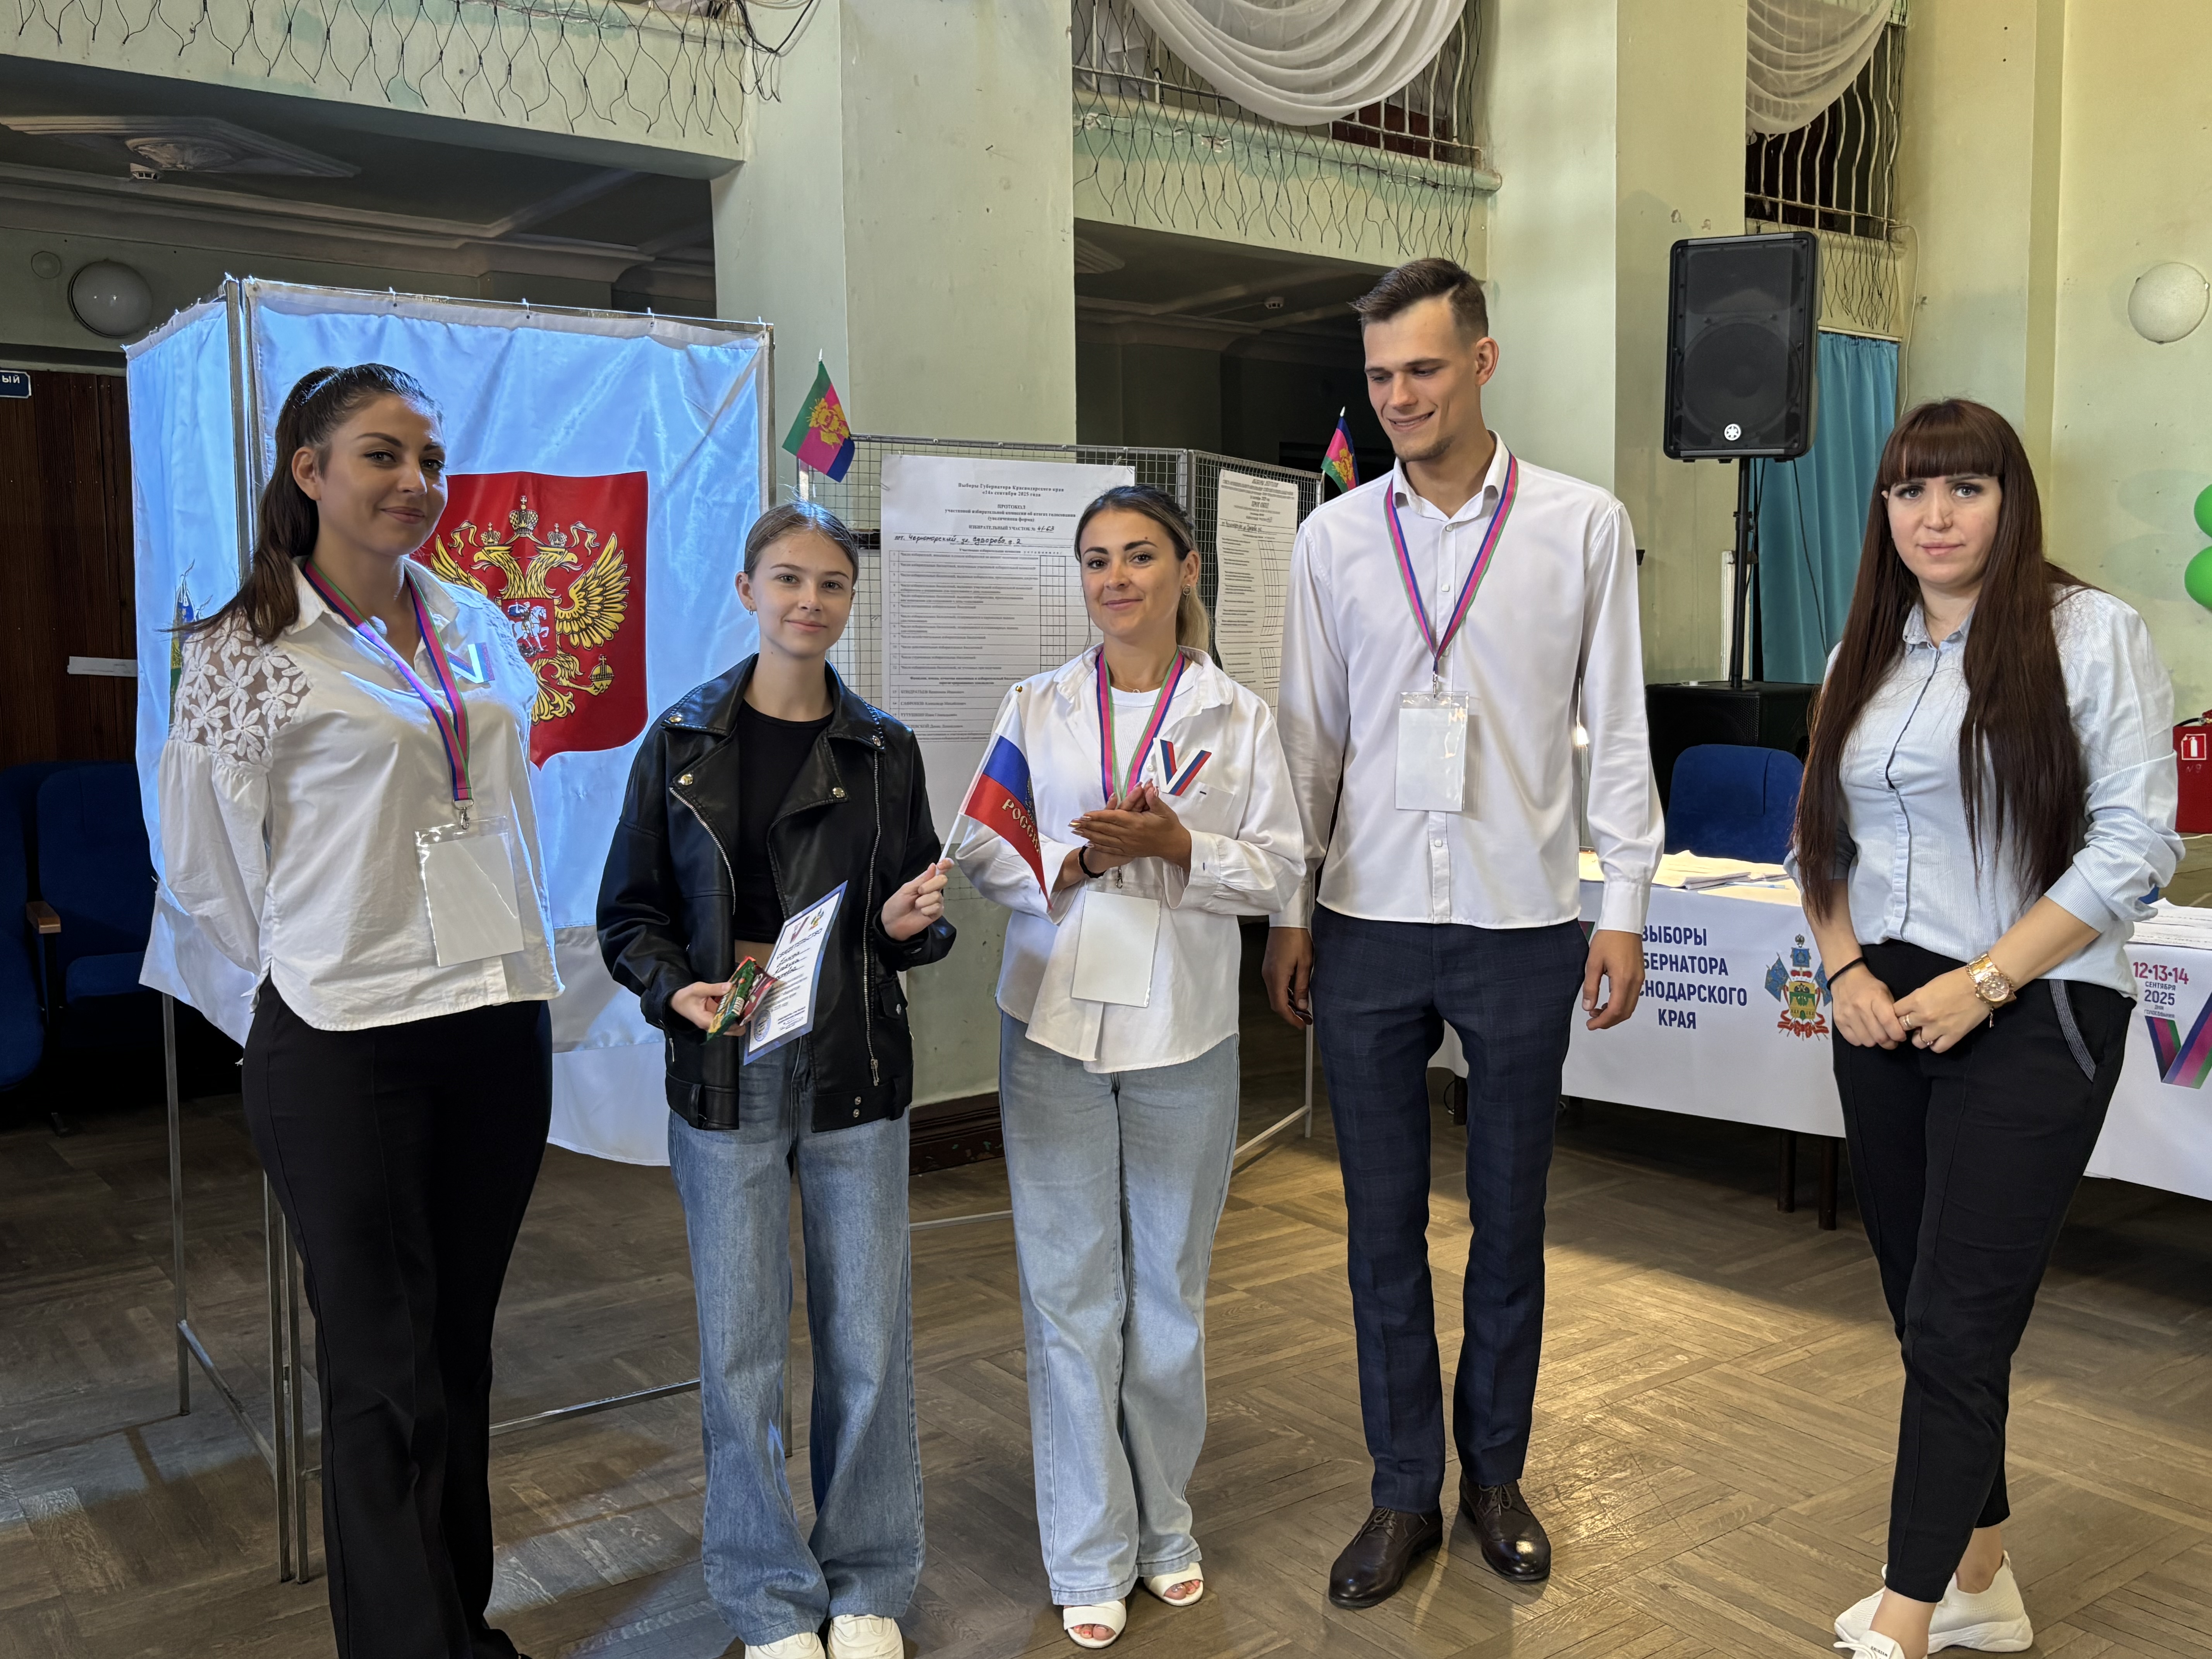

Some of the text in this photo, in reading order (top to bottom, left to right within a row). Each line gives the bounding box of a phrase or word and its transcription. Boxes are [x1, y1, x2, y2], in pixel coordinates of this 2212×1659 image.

[1644, 952, 1728, 976] БЕРНАТОРА
[1639, 980, 1747, 1006] НОДАРСКОГО
[2145, 981, 2176, 991] СЕНТЯБРЯ
[2144, 989, 2175, 1006] 2025
[1658, 1008, 1696, 1029] КРАЯ
